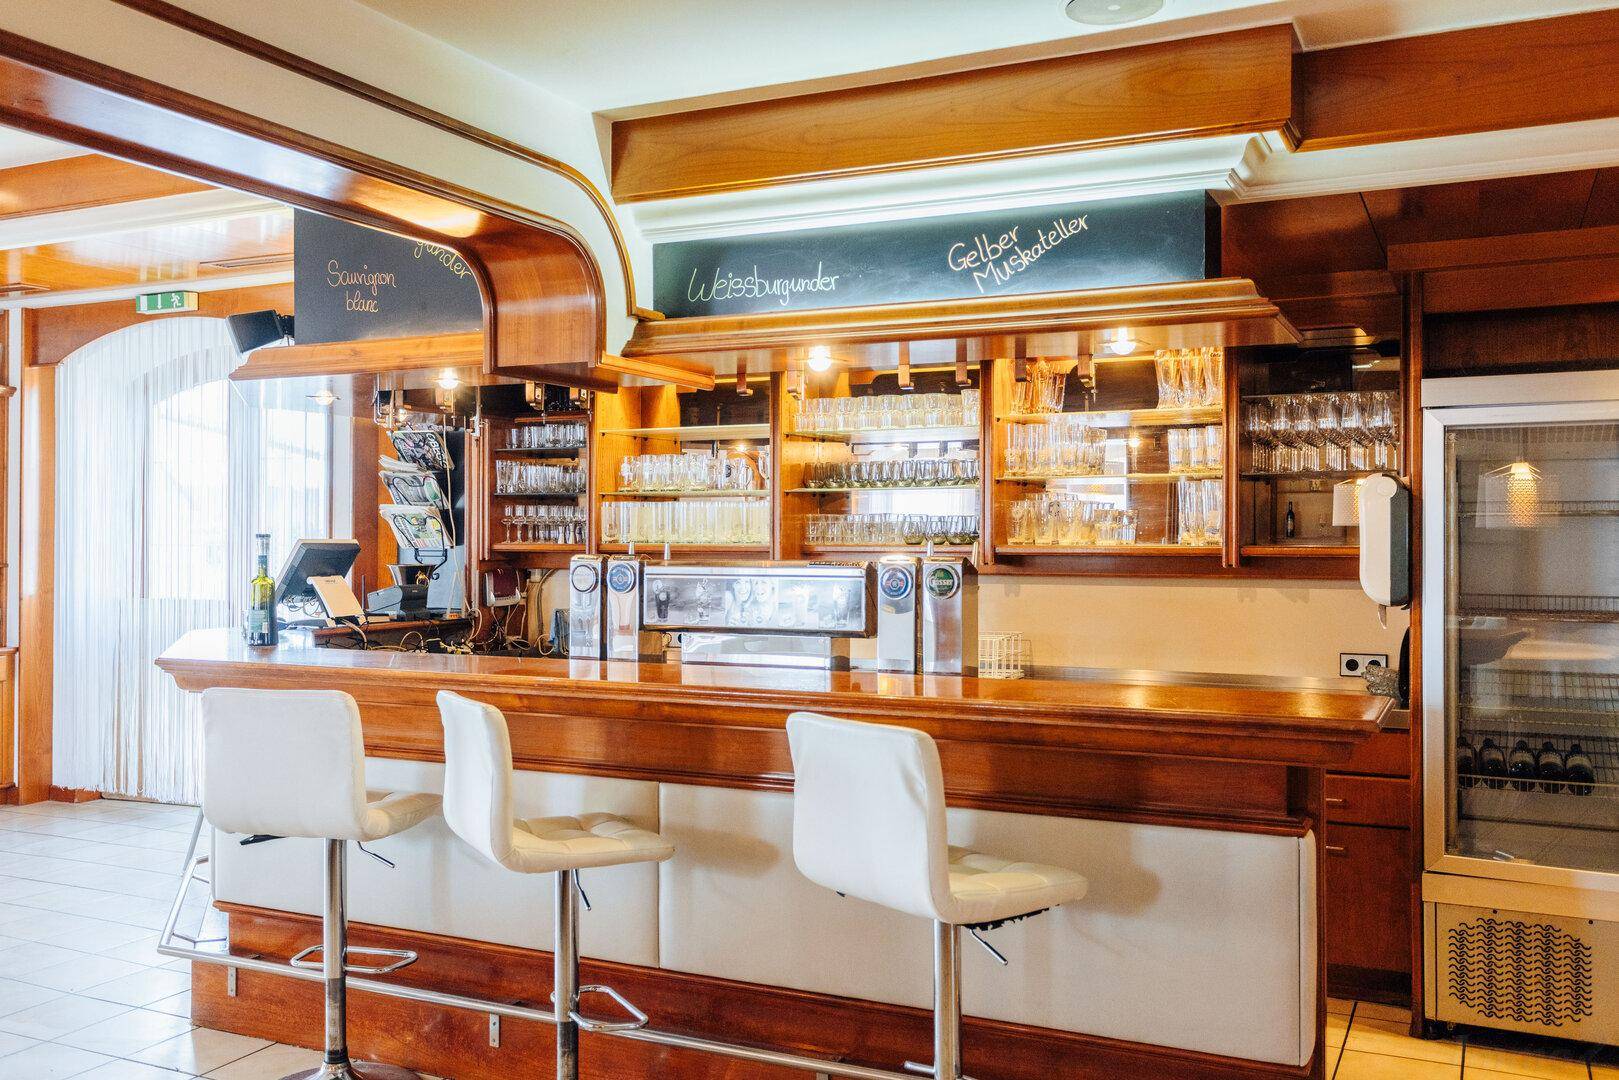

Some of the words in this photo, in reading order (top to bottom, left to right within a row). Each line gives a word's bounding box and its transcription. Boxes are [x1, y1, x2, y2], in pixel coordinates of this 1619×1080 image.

[948, 225, 1019, 271] Gelber
[973, 214, 1089, 293] Muskateller
[327, 259, 397, 296] Sauvignon
[687, 260, 840, 306] Weissburgunder
[346, 290, 379, 313] blanc
